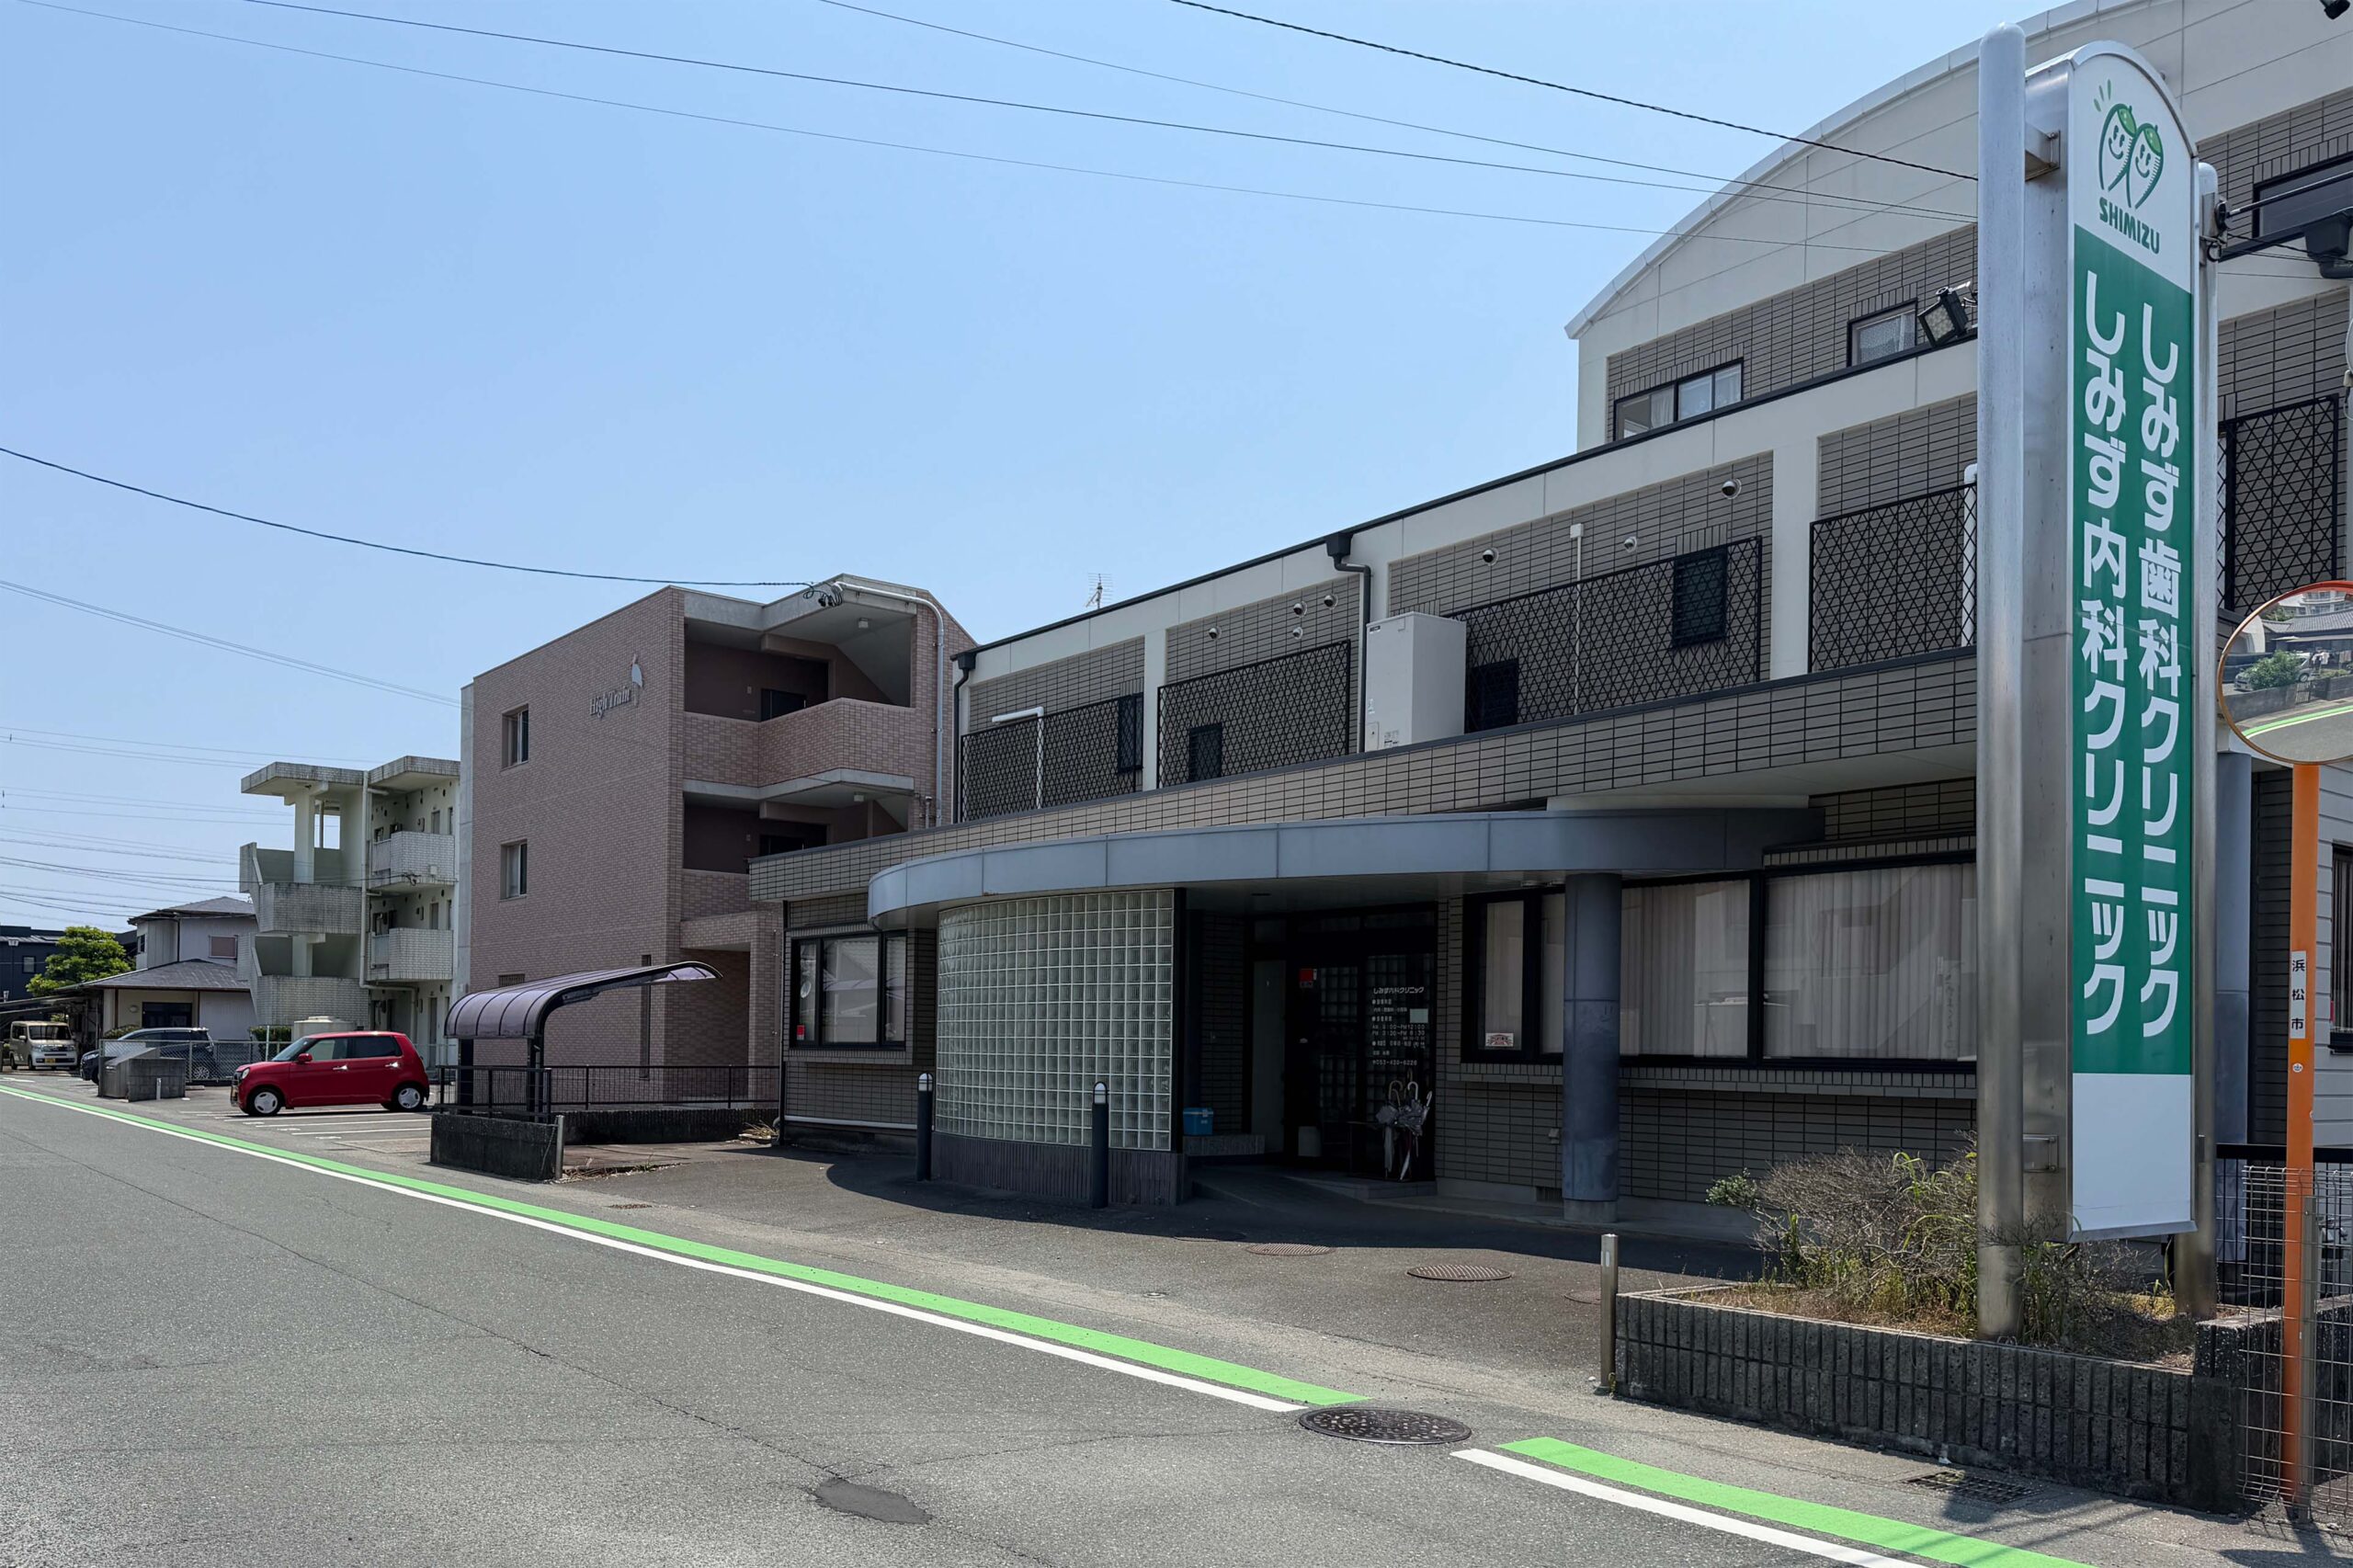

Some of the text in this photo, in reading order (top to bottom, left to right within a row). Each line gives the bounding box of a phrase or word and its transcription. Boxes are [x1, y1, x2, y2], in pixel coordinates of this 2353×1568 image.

[2099, 196, 2160, 255] SHIMIZU
[2081, 269, 2127, 1035] しみず内科クリニック
[2139, 301, 2182, 1038] しみず歯科クリニック
[589, 693, 608, 719] High
[2291, 959, 2305, 1030] 浜松市
